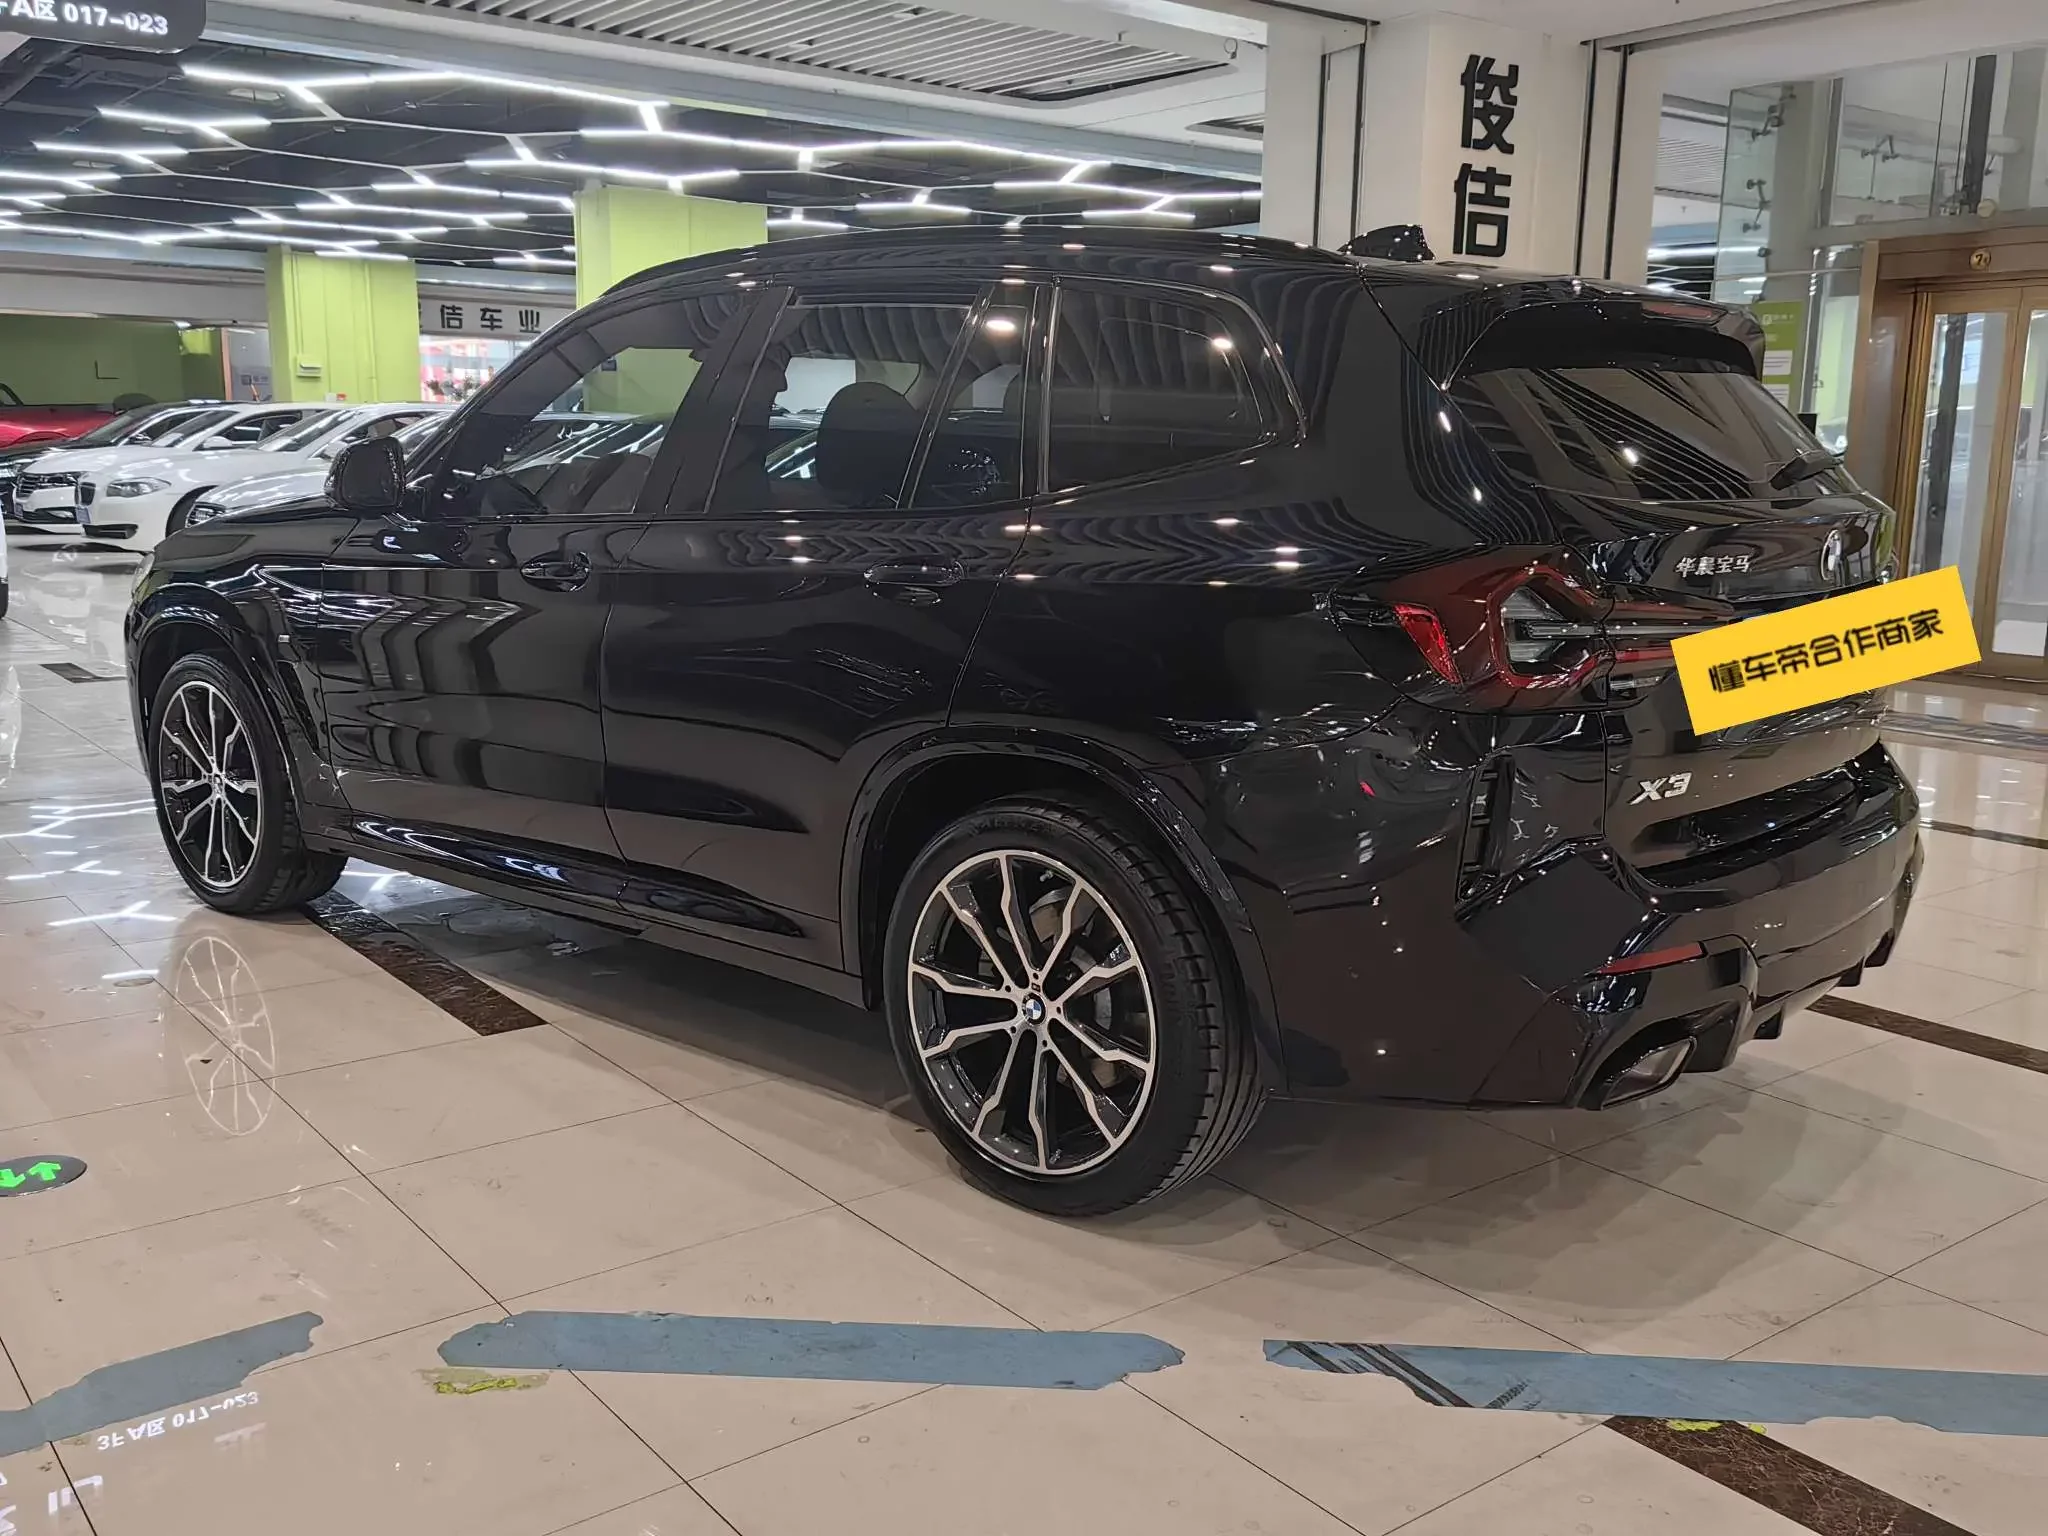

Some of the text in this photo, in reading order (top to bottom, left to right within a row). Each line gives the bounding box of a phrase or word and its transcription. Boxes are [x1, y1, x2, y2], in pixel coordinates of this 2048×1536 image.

[63, 3, 168, 35] 017-023
[418, 303, 542, 333] 佶车业
[1675, 555, 1751, 578] 华晨宝马
[1629, 772, 1692, 806] X3
